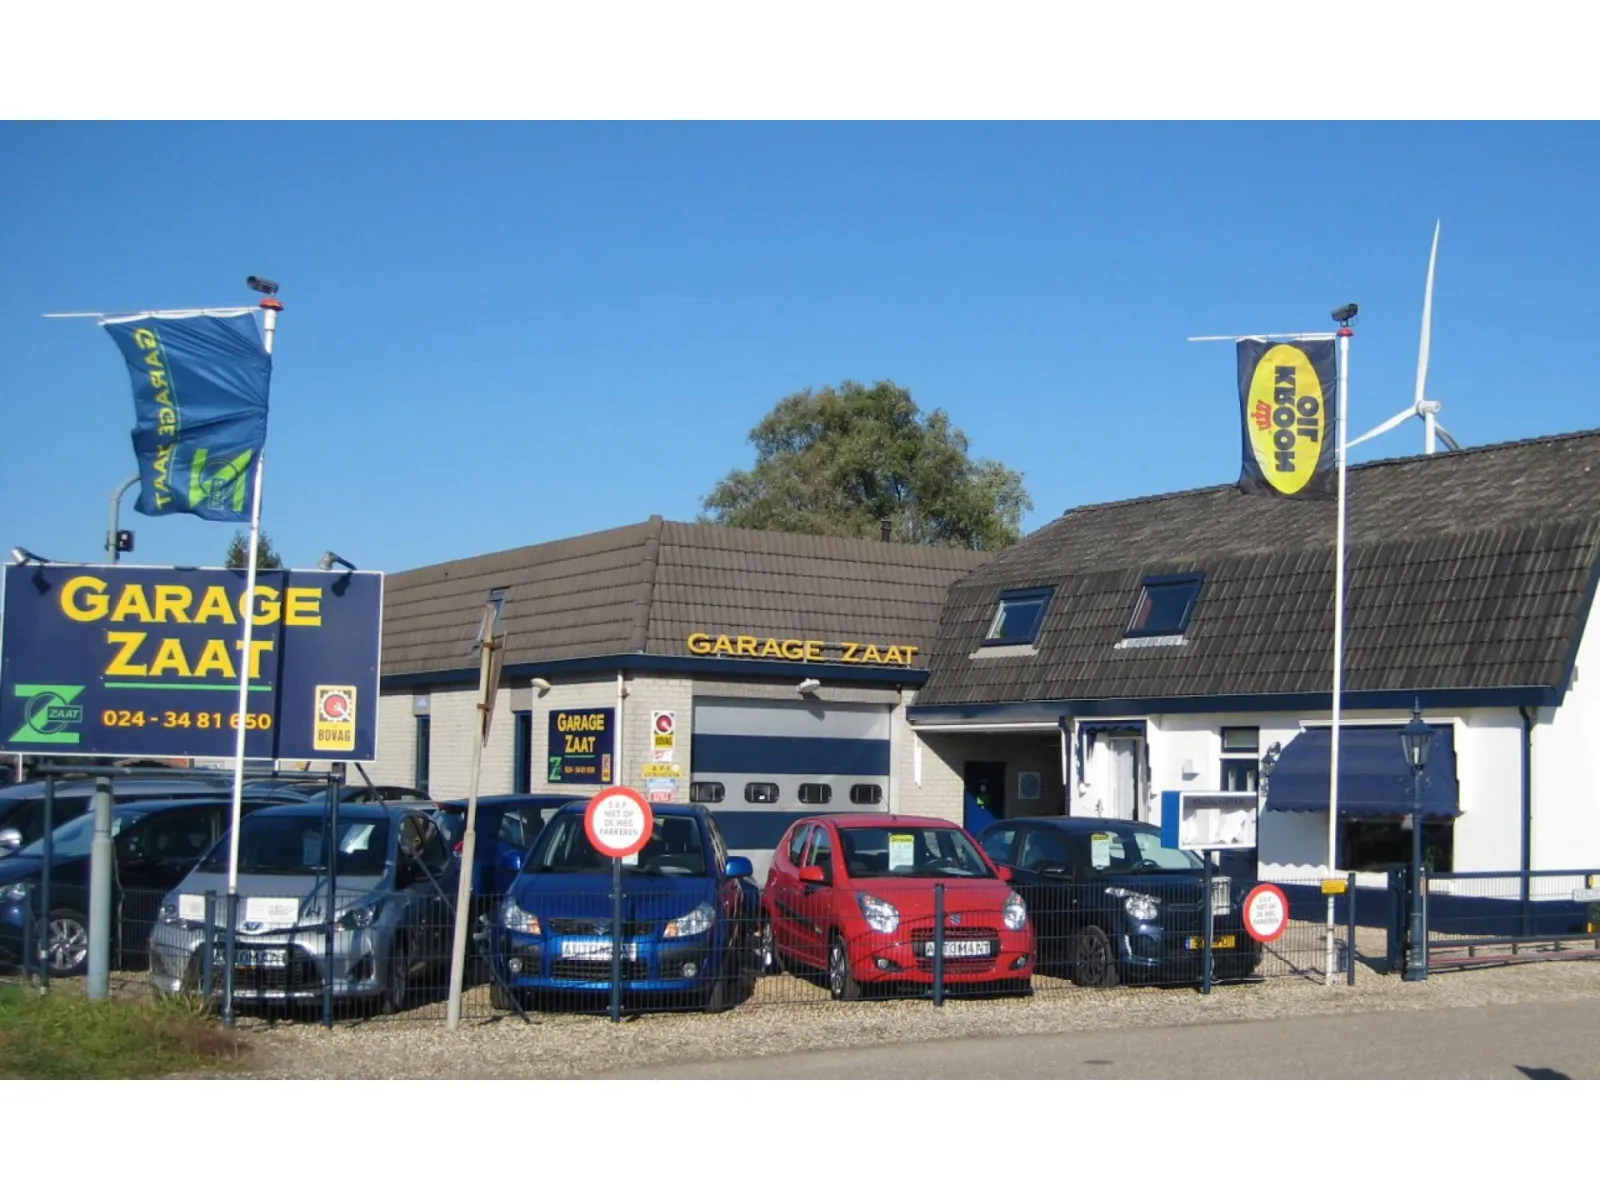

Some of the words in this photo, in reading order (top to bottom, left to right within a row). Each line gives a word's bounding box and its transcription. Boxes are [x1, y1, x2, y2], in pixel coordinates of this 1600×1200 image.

[61, 576, 322, 626] GARAGE
[105, 632, 274, 678] ZAAT
[688, 632, 824, 661] GARAGE
[841, 641, 918, 665] ZAAT
[48, 708, 80, 719] ZAAT
[103, 709, 145, 728] 024
[164, 710, 191, 728] 34
[196, 711, 222, 729] 81
[229, 713, 271, 730] 650
[557, 713, 605, 732] GARAGE
[317, 729, 351, 742] BOVAG
[564, 735, 596, 753] ZAAT
[926, 943, 991, 954] ATOMART
